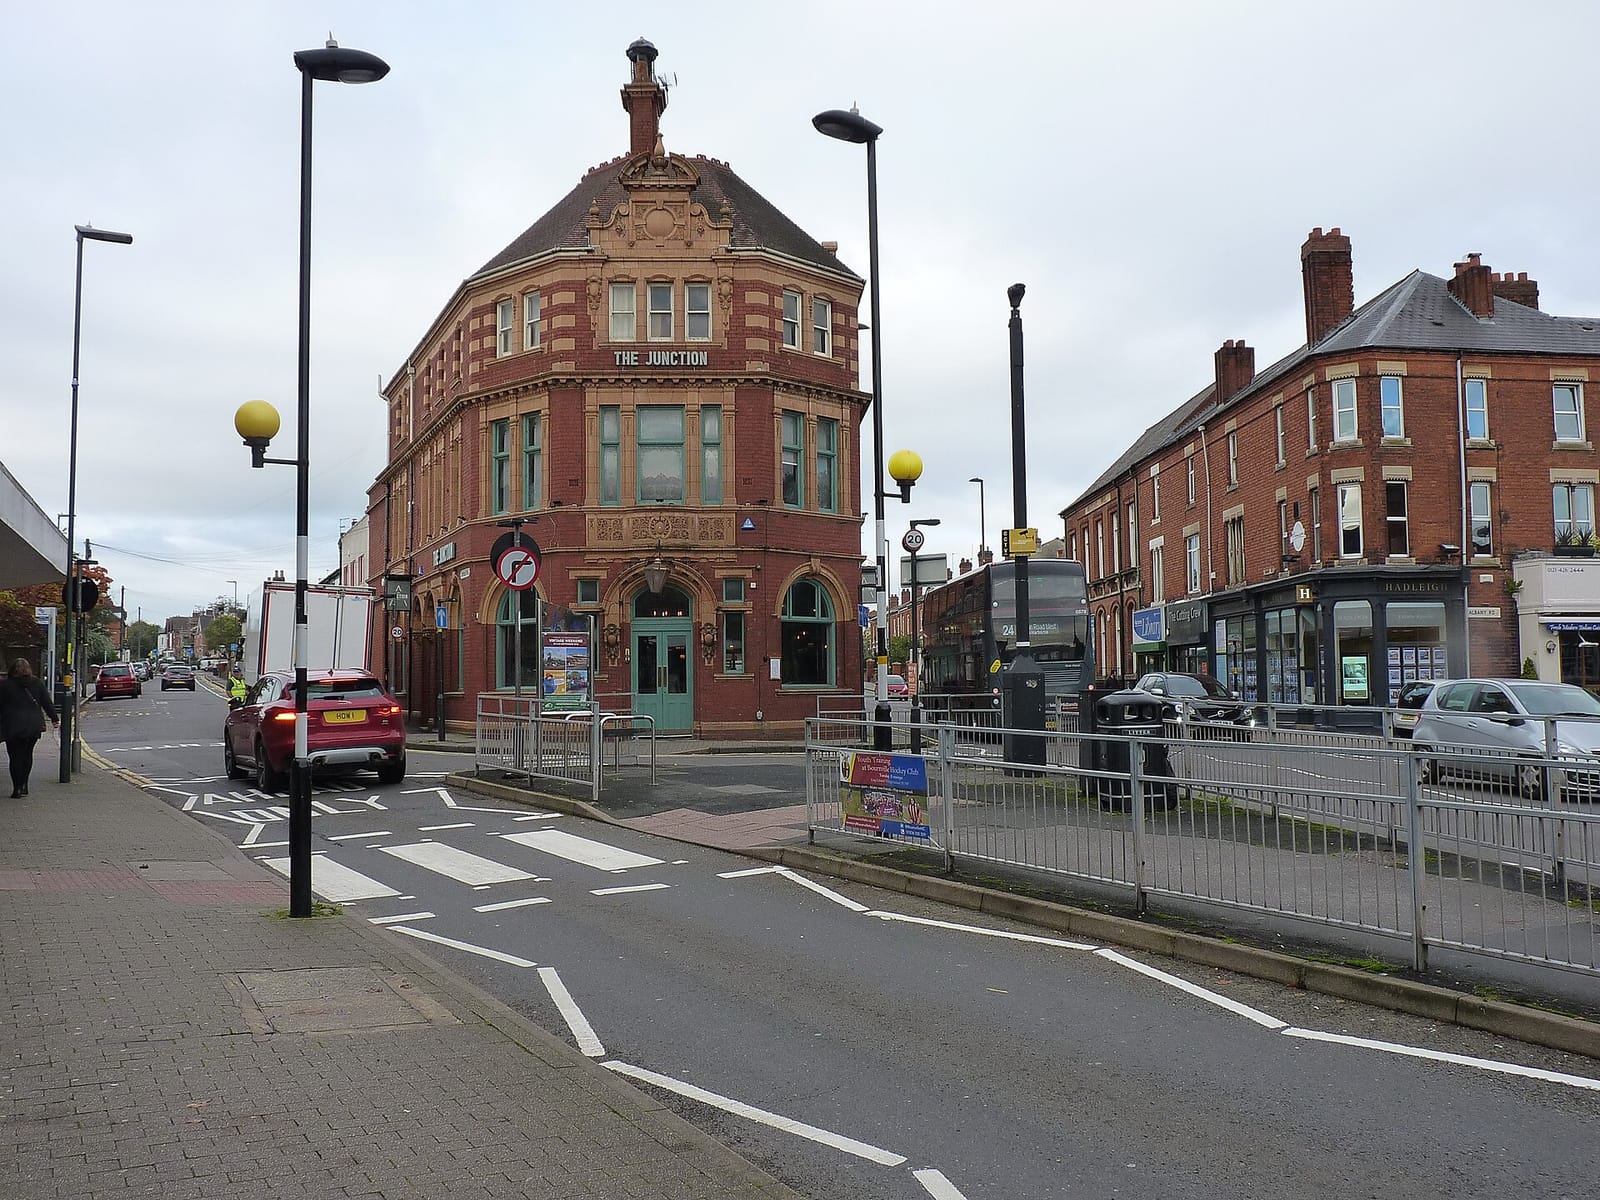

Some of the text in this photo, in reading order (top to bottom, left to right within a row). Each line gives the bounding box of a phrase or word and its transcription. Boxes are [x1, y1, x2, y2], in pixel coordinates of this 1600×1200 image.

[613, 351, 708, 366] THE JUNCTION
[907, 534, 922, 544] 20
[1384, 583, 1448, 592] HADLEIGH
[1299, 588, 1311, 599] H
[1002, 624, 1014, 636] 24
[856, 755, 891, 767] Youth Training
[890, 766, 906, 776] Hockey
[906, 767, 919, 776] Club
